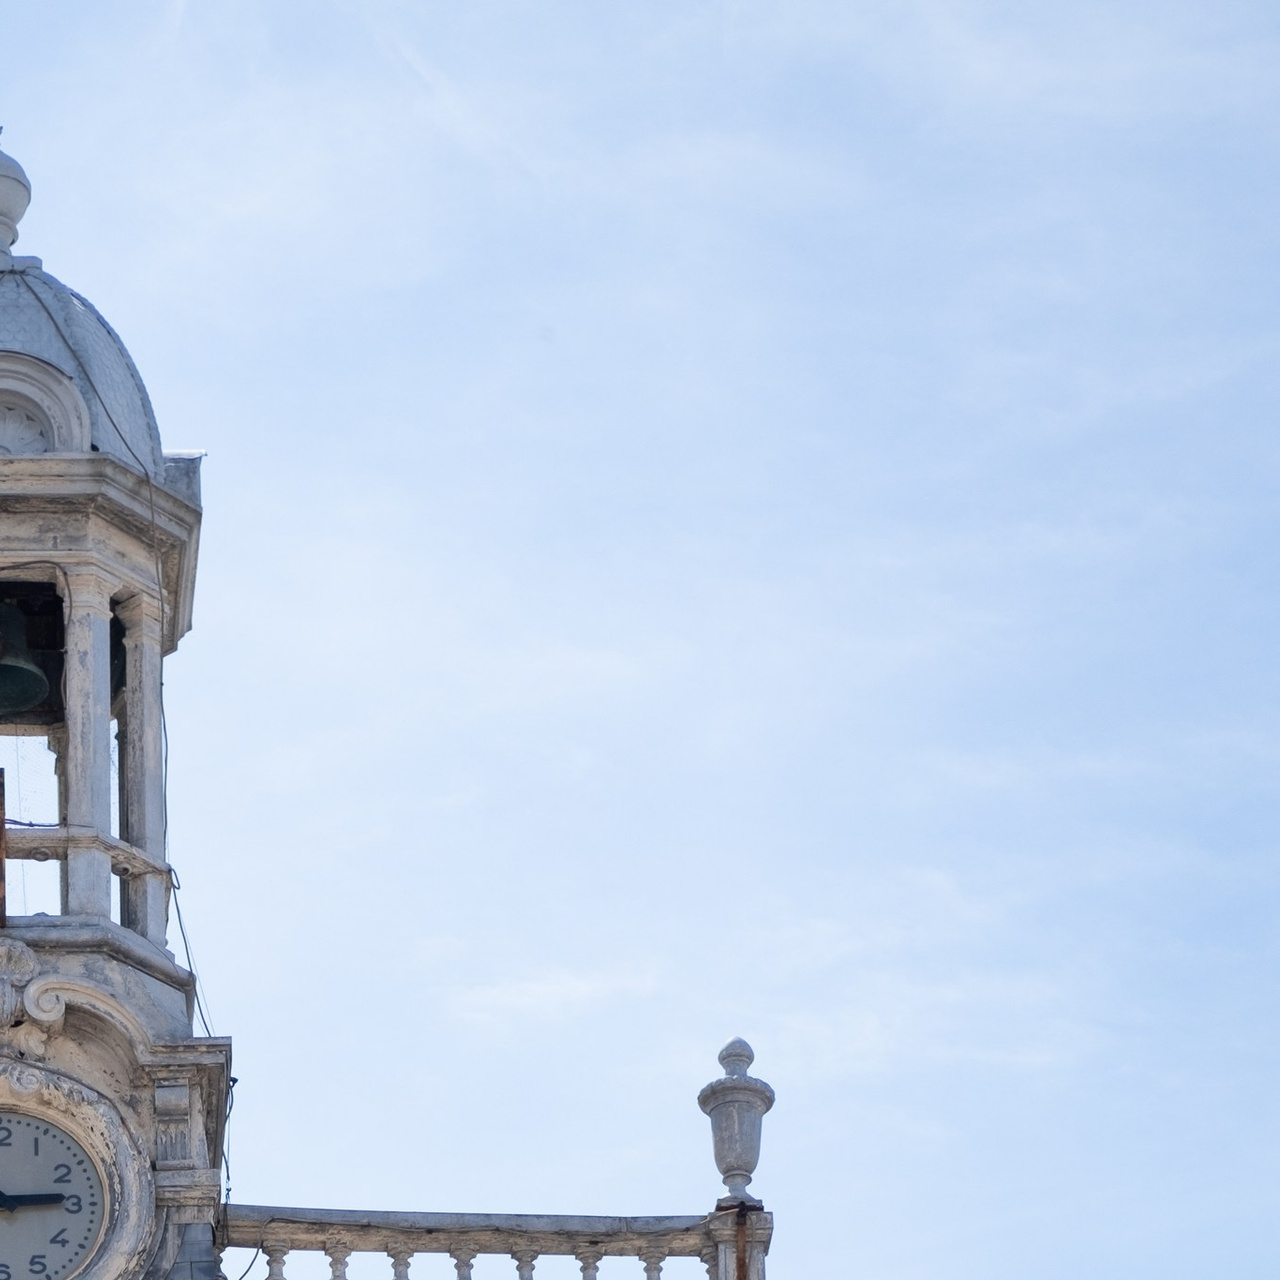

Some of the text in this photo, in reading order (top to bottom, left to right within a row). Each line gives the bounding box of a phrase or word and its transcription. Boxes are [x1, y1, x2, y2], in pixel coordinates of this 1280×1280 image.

[33, 1136, 40, 1157] 1
[53, 1164, 72, 1184] 2
[64, 1194, 83, 1214] 3
[50, 1228, 69, 1248] 4
[28, 1255, 47, 1275] 5
